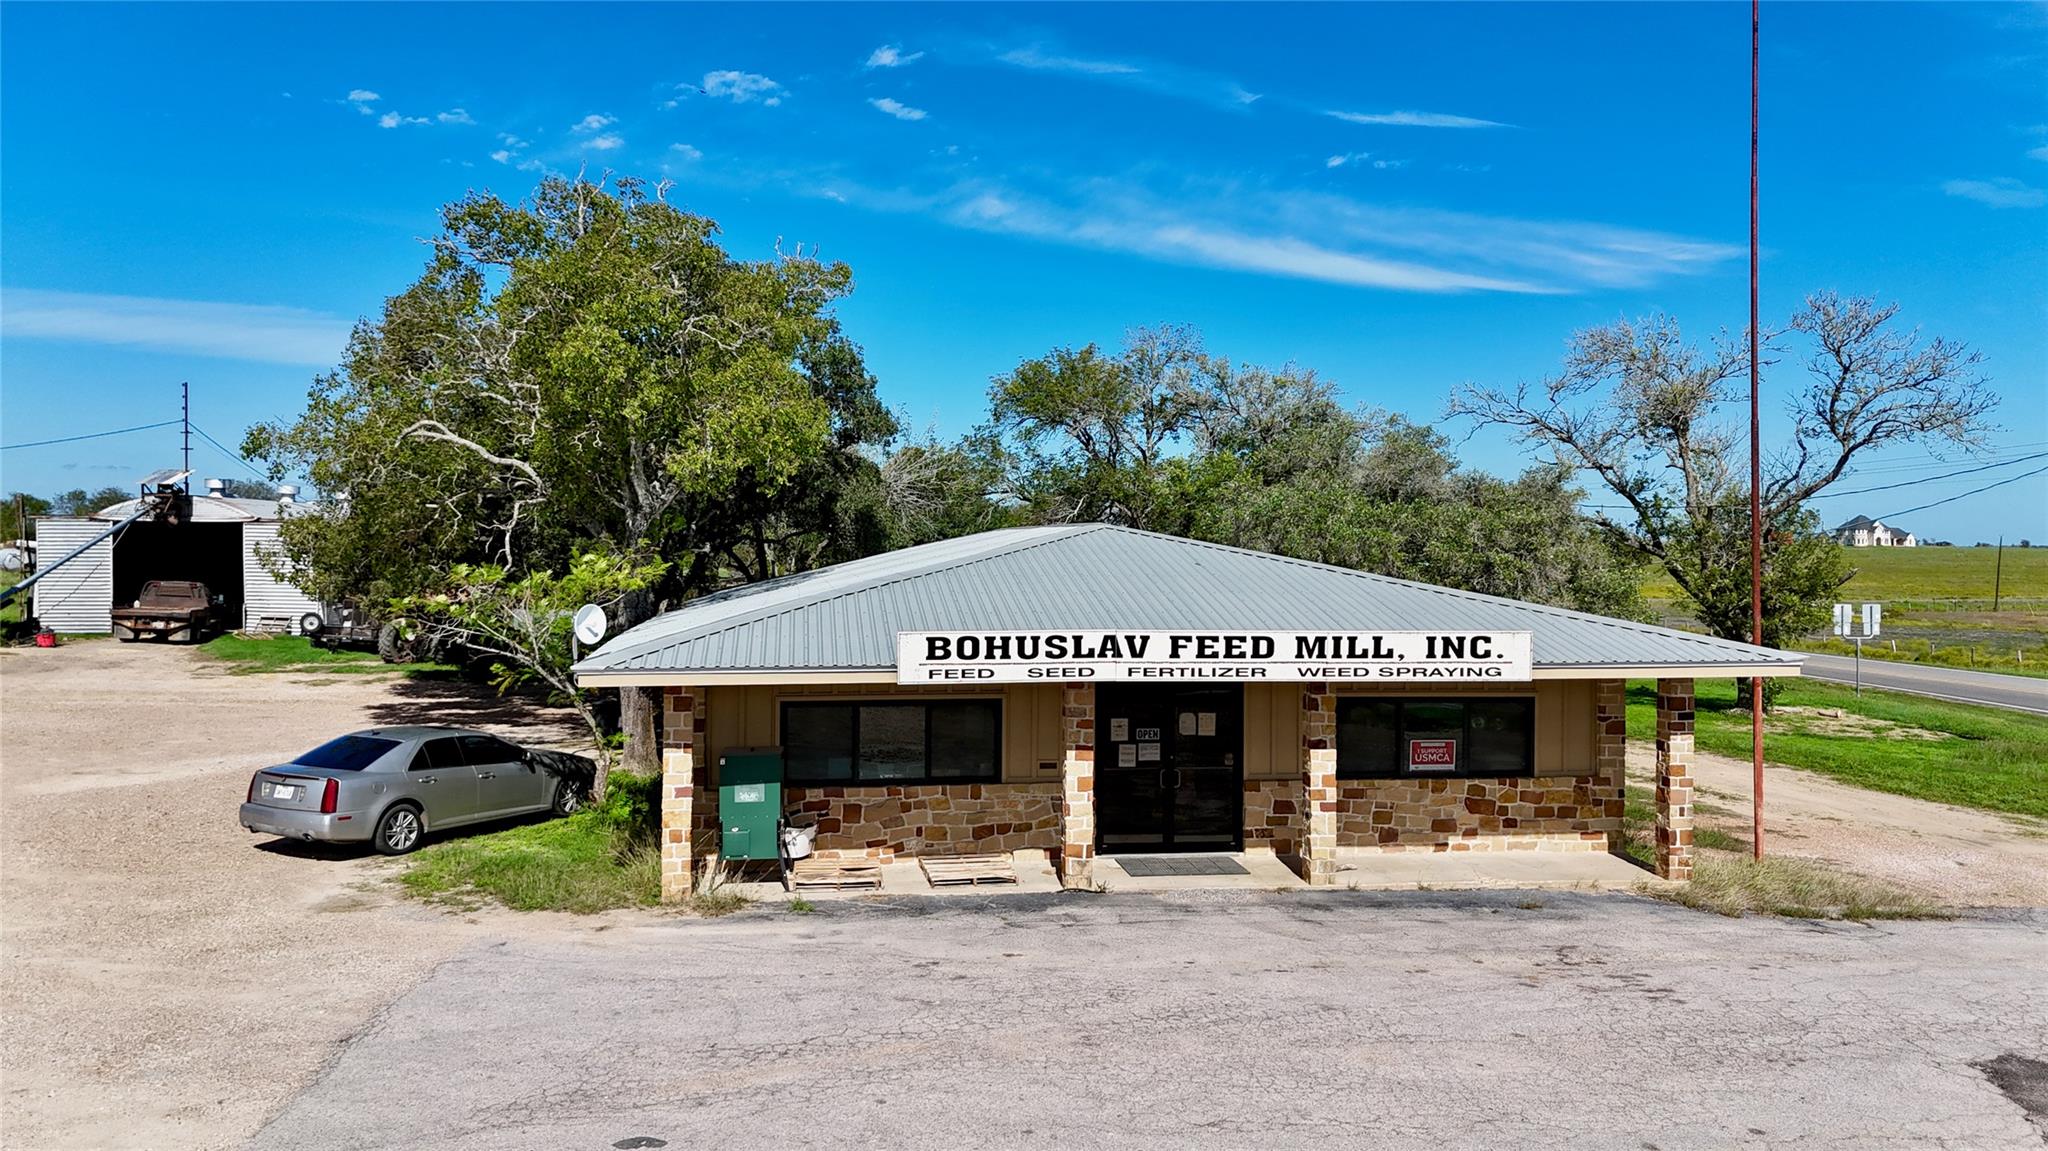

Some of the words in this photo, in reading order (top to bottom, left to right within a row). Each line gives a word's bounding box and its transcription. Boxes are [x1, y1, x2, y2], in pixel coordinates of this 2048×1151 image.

[925, 634, 1151, 661] BOHUSLAV
[1168, 635, 1275, 659] FEED
[1294, 635, 1405, 662] MILL,
[1425, 636, 1504, 660] INC.
[928, 668, 995, 680] FEED
[1027, 667, 1095, 678] SEED
[1127, 667, 1267, 678] FERTILIZER
[1297, 667, 1370, 677] WEED
[1378, 667, 1502, 677] SPRAYING
[1137, 729, 1159, 739] OPEN
[1415, 754, 1450, 762] USMCA
